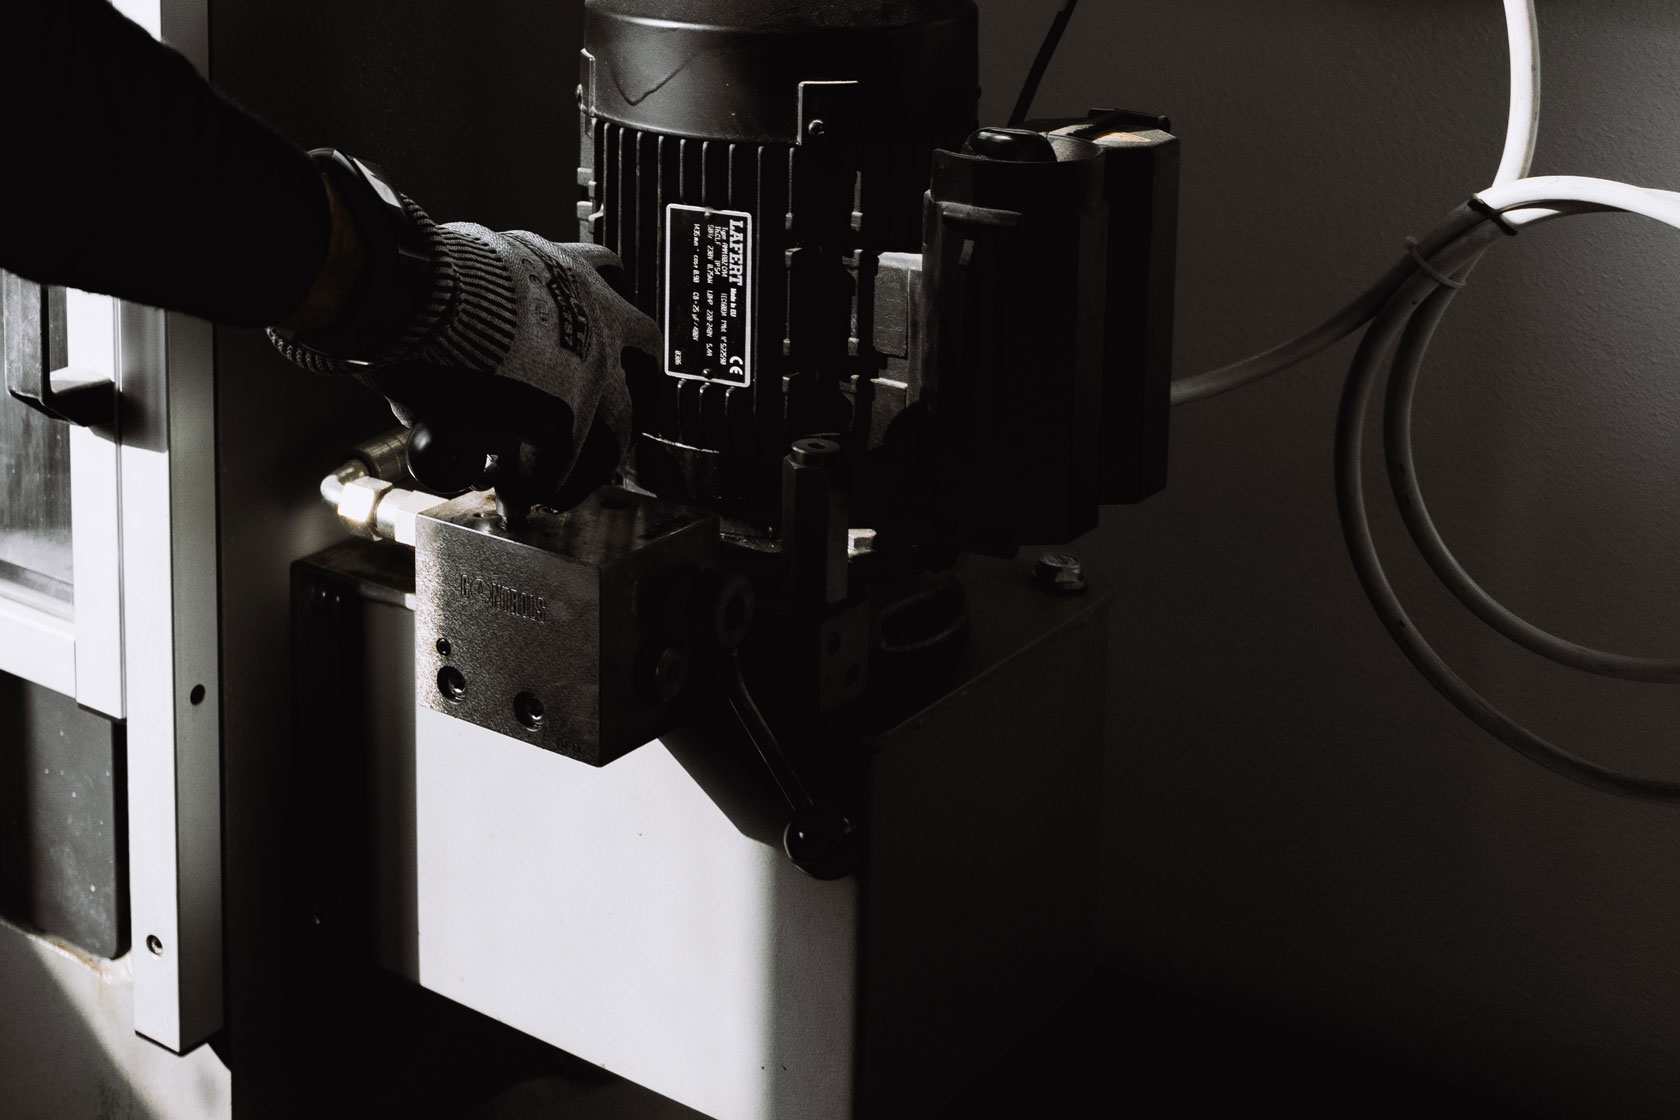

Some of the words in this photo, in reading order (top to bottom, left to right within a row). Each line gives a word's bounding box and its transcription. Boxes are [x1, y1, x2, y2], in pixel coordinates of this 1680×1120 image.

[729, 219, 743, 286] LAFERT
[729, 287, 737, 302] Made
[729, 308, 737, 318] EU
